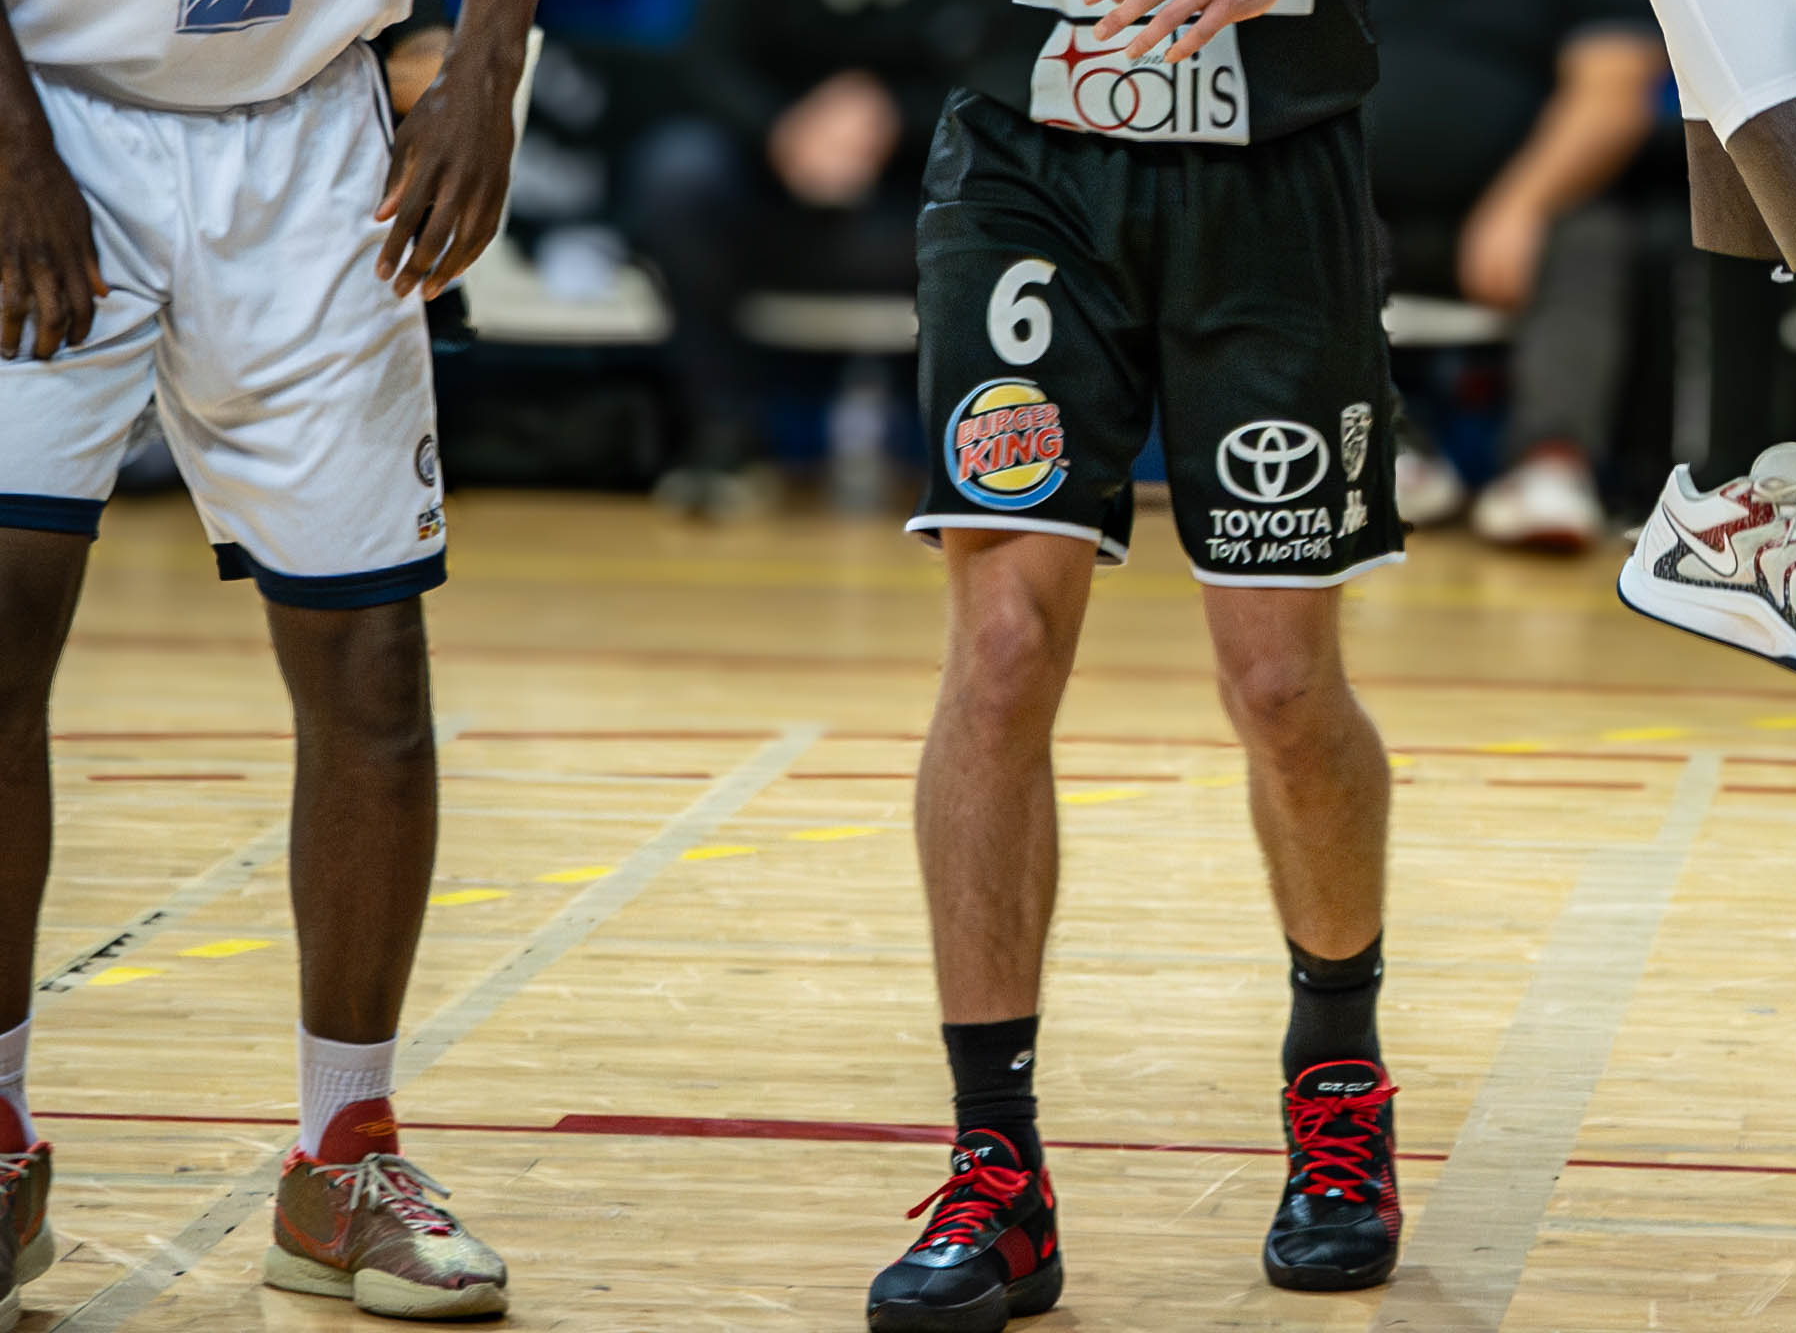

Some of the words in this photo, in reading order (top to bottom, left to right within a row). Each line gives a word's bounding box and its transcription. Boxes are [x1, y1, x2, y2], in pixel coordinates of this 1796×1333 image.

[987, 258, 1057, 366] 6
[956, 403, 1060, 449] BURGER
[959, 426, 1065, 484] KING
[1209, 507, 1332, 539] TOYOTA
